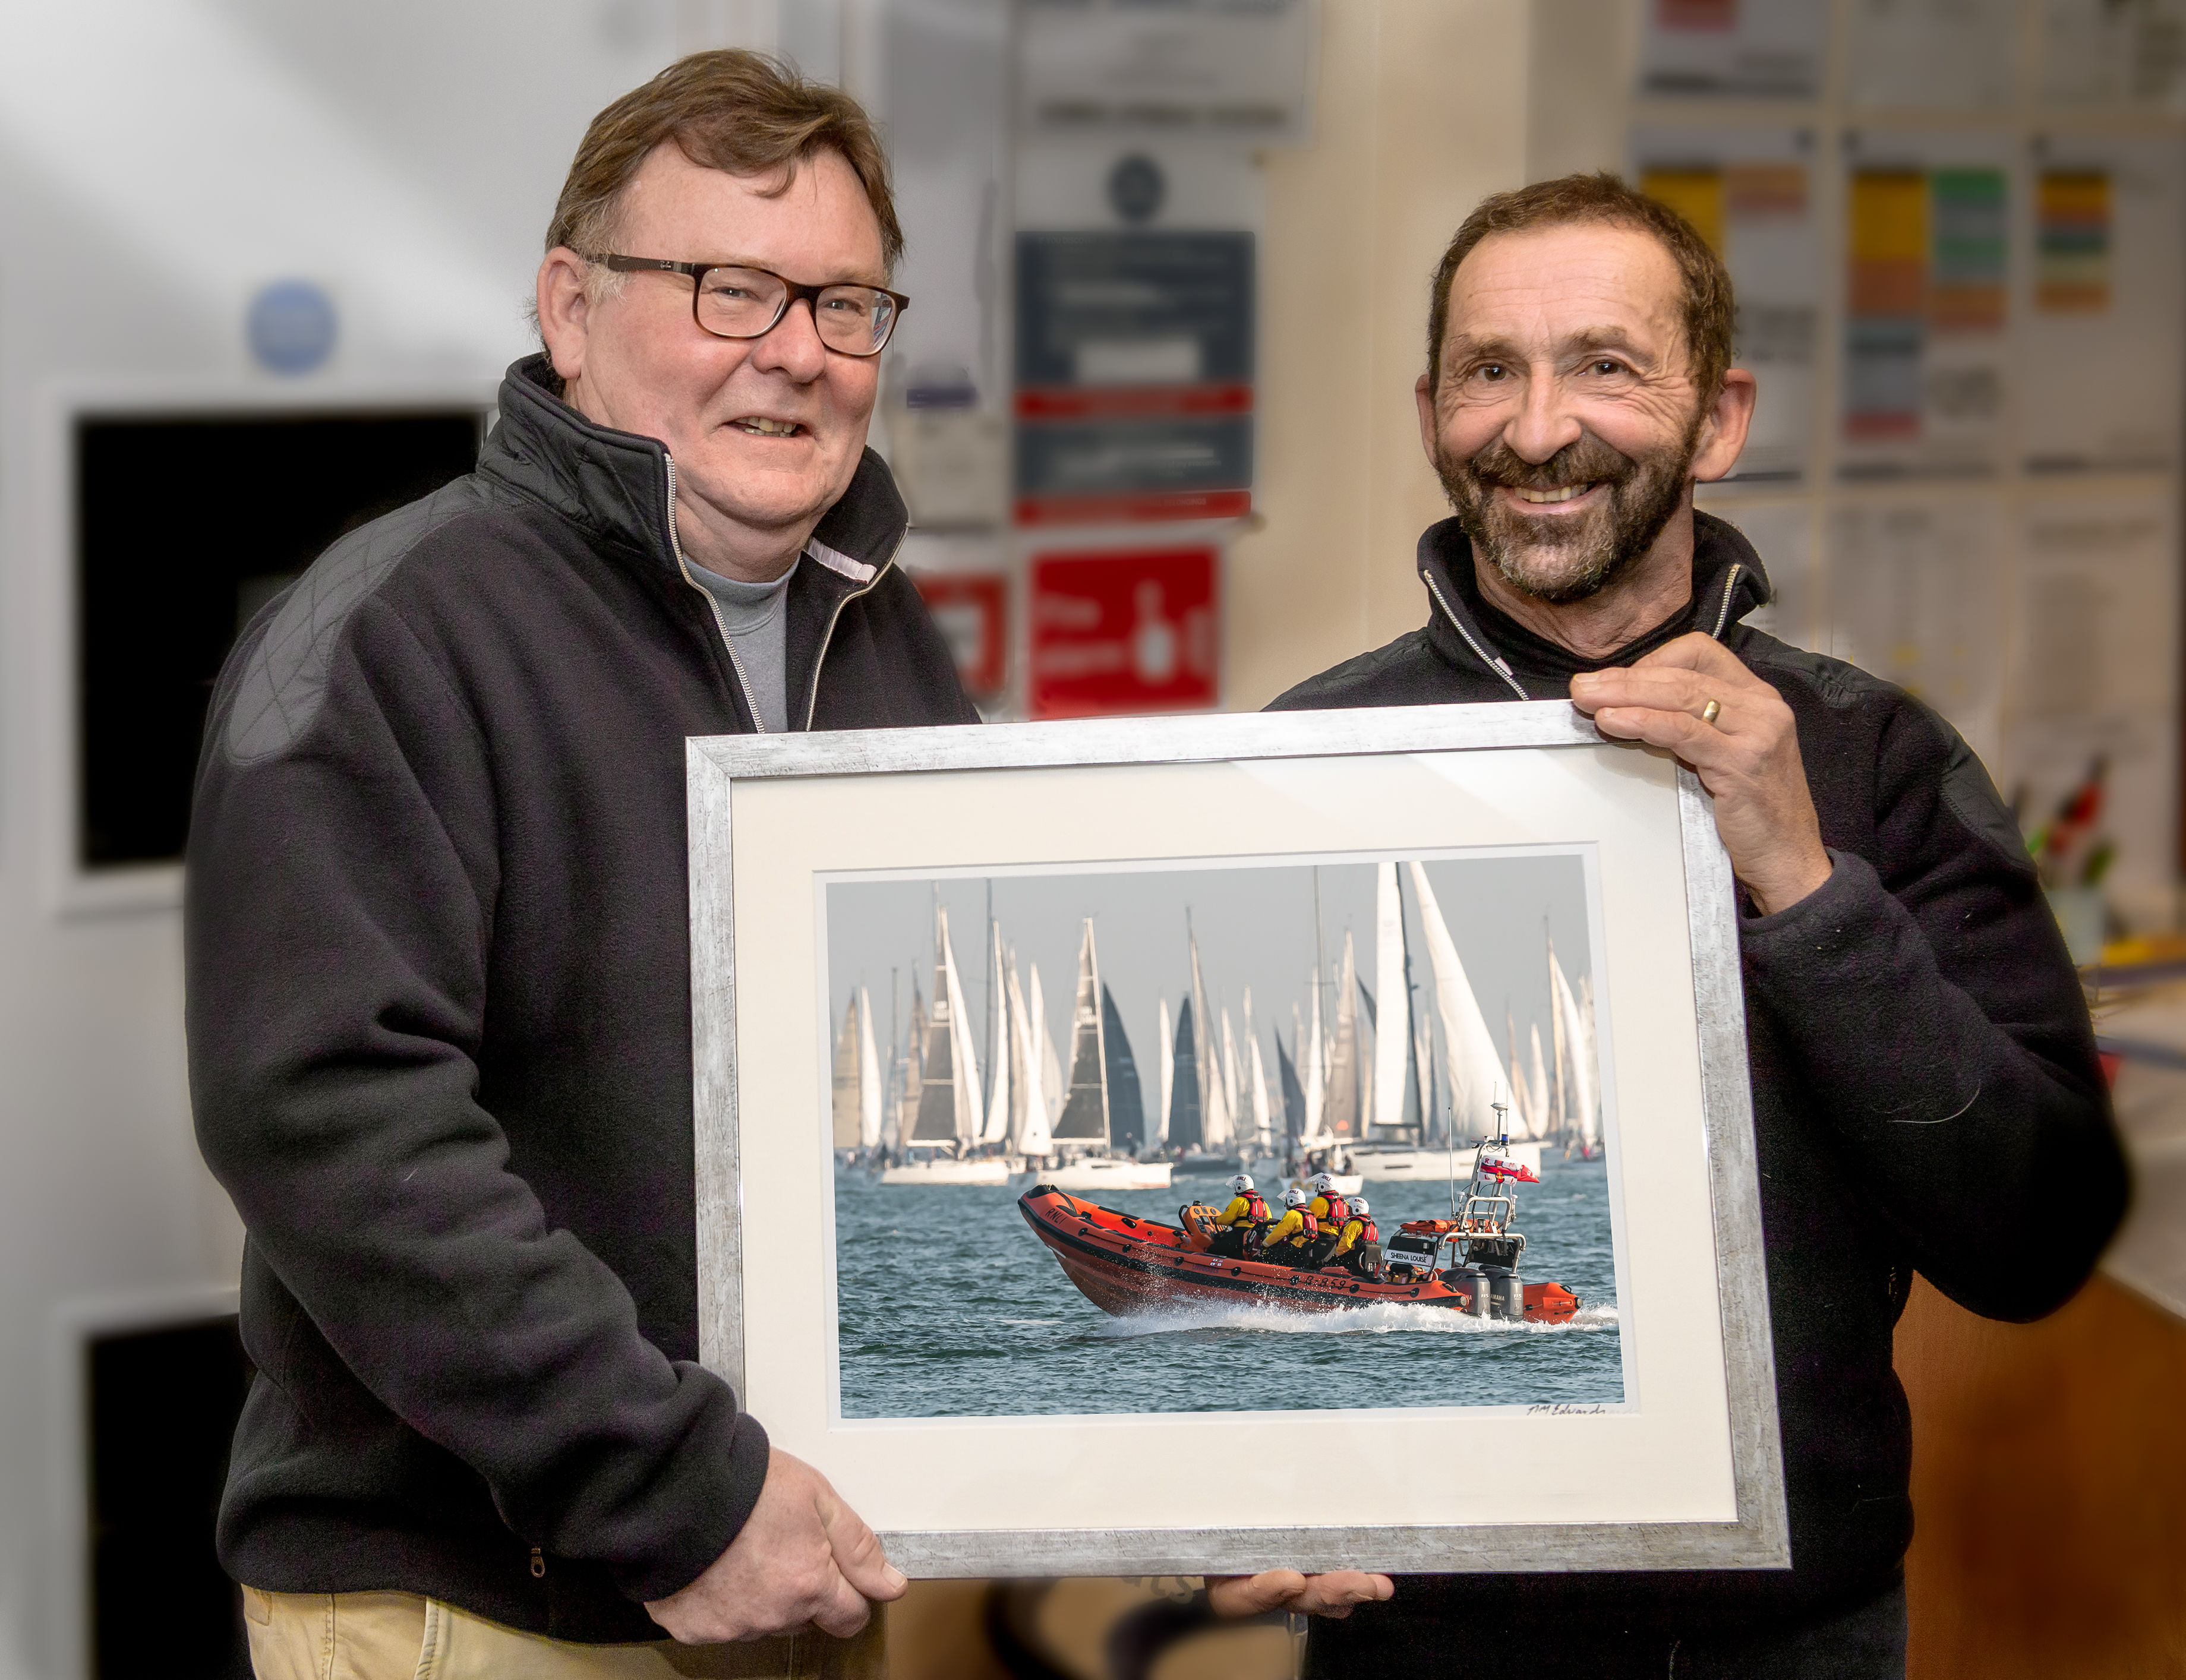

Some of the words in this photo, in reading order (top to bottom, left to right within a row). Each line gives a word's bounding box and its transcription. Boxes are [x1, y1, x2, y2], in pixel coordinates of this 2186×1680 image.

[1045, 1208, 1068, 1225] RNLI
[1390, 1252, 1409, 1261] SHEENA
[1410, 1255, 1427, 1263] LOUISE
[1192, 1264, 1219, 1274] Lifeboats
[1490, 1293, 1505, 1302] AMAHA
